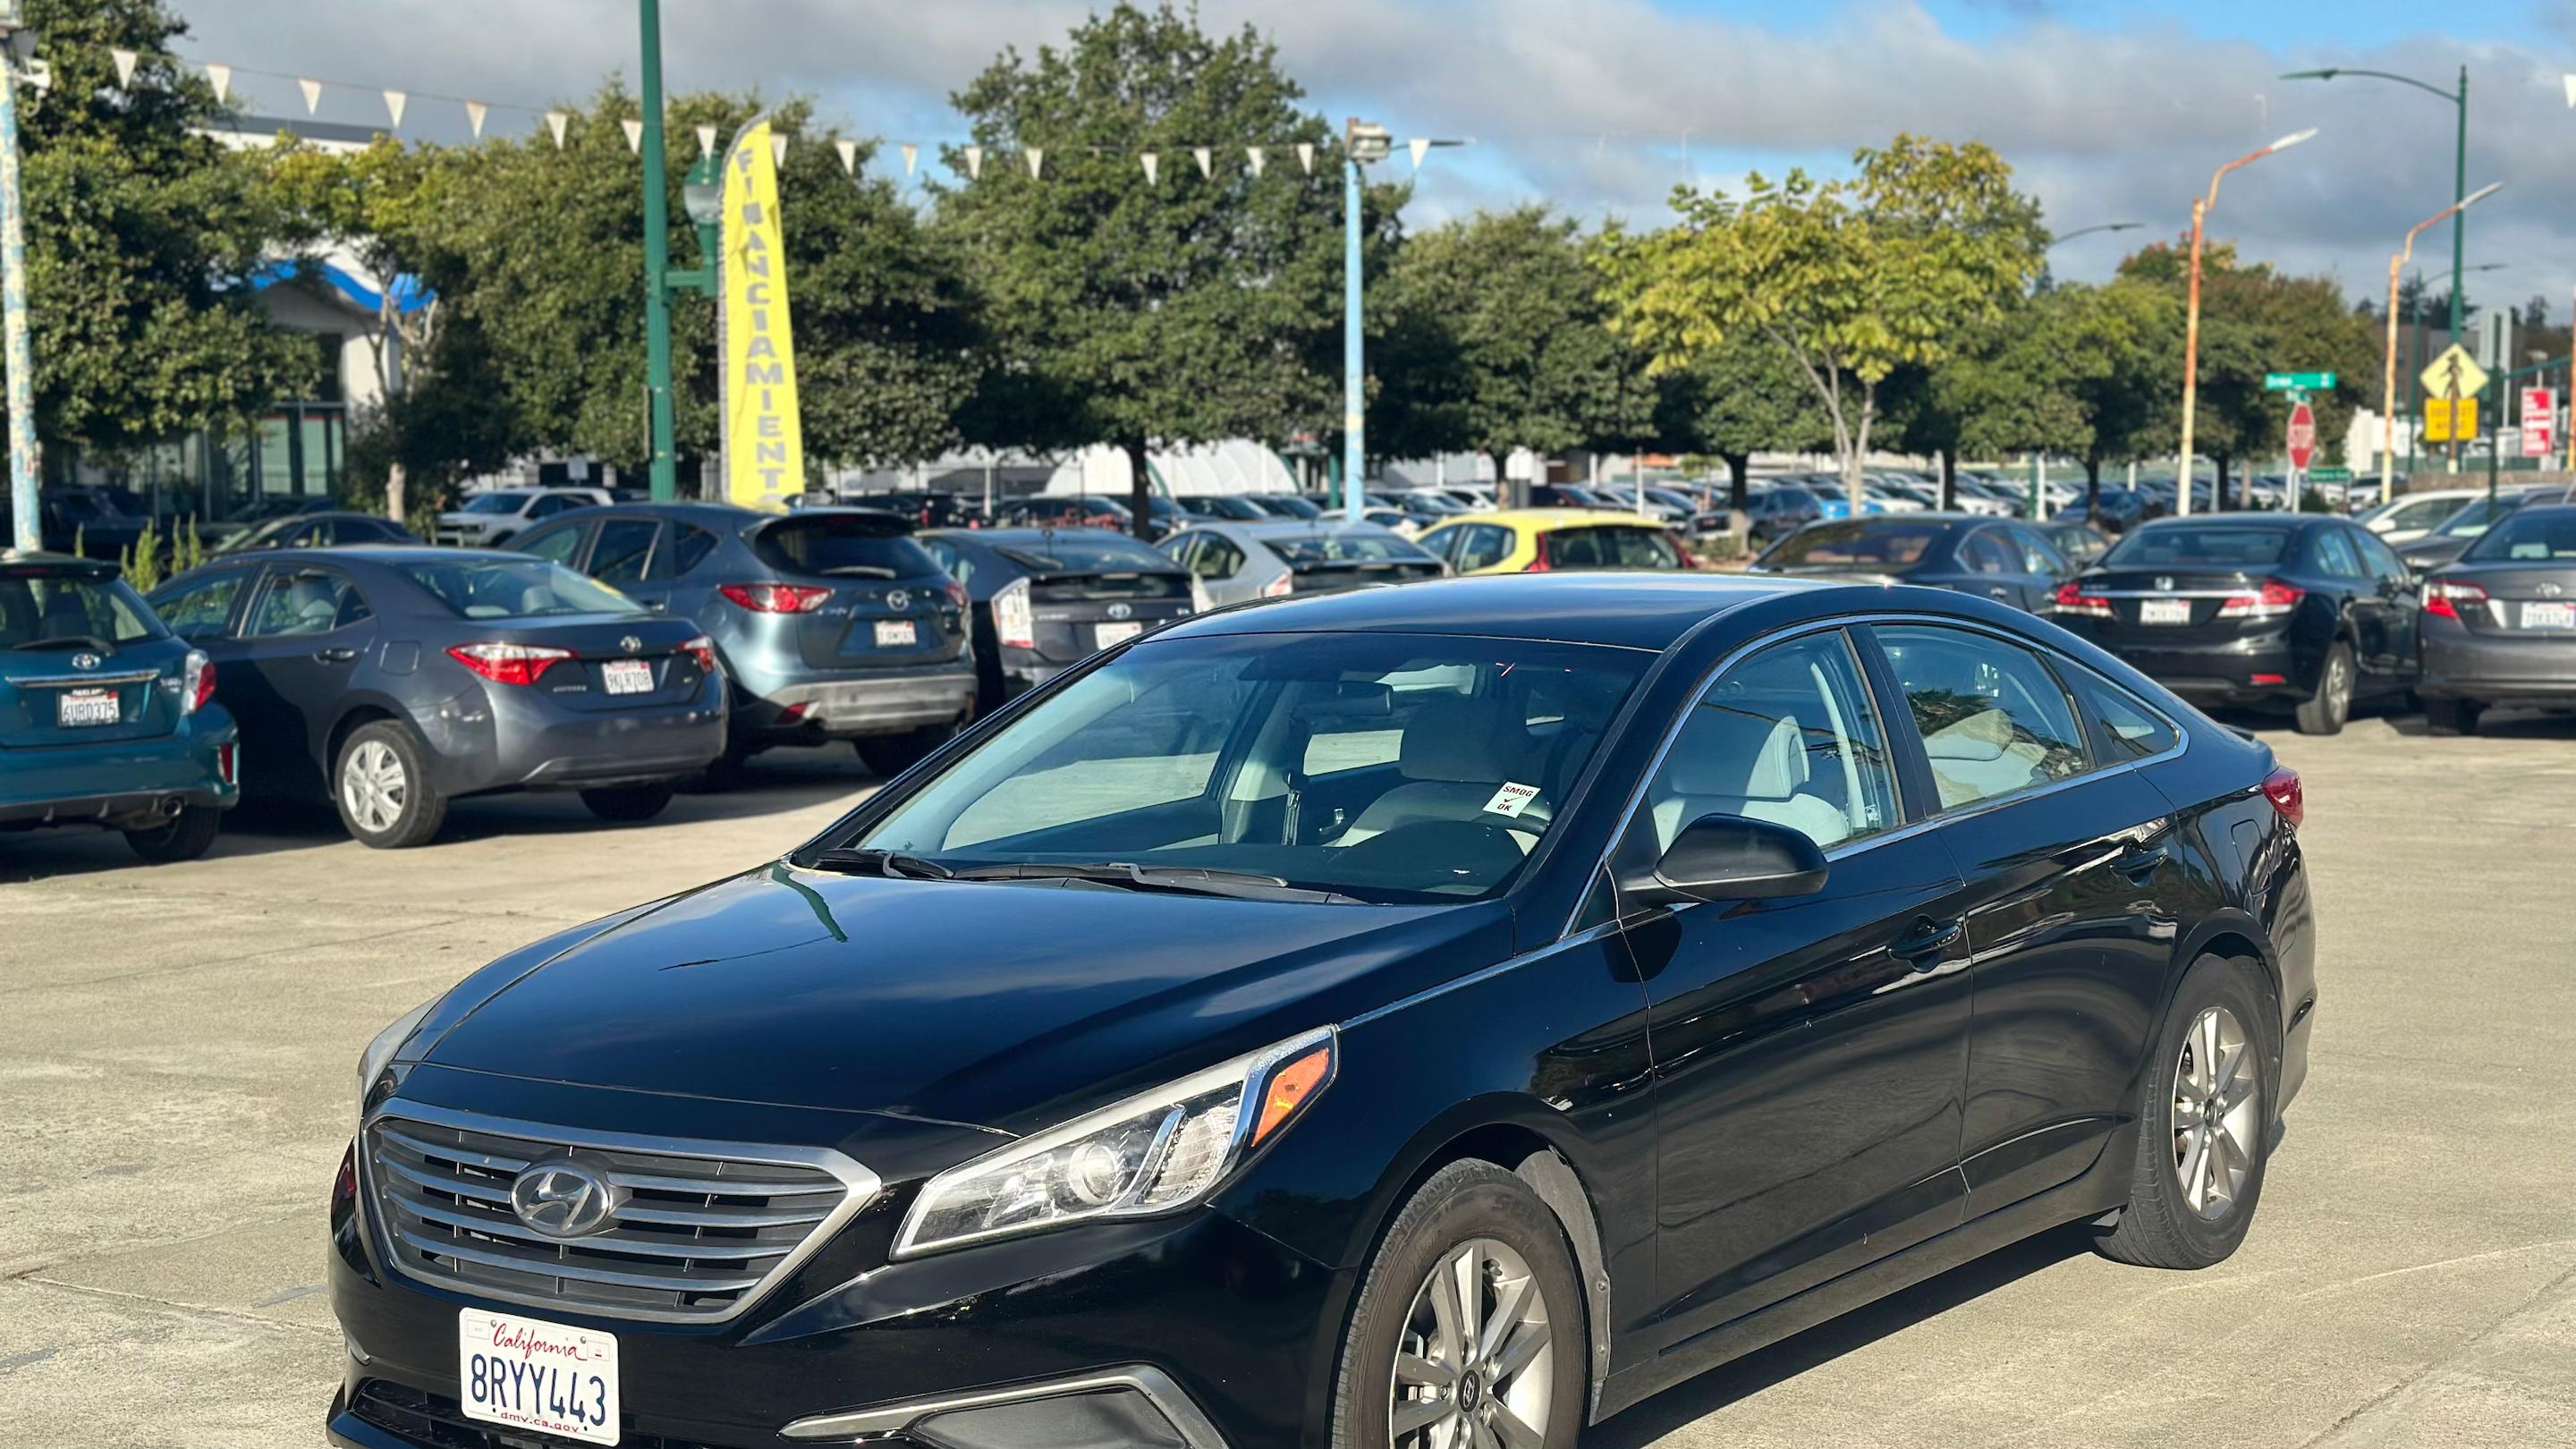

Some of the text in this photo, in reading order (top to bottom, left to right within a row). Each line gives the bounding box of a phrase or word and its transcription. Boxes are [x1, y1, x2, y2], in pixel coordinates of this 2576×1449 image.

[2288, 424, 2315, 449] STOP
[1504, 786, 1533, 797] SMOG
[493, 1323, 588, 1360] California
[470, 1353, 606, 1427] 8RYY443
[500, 1411, 580, 1434] dmv.ca.gov
